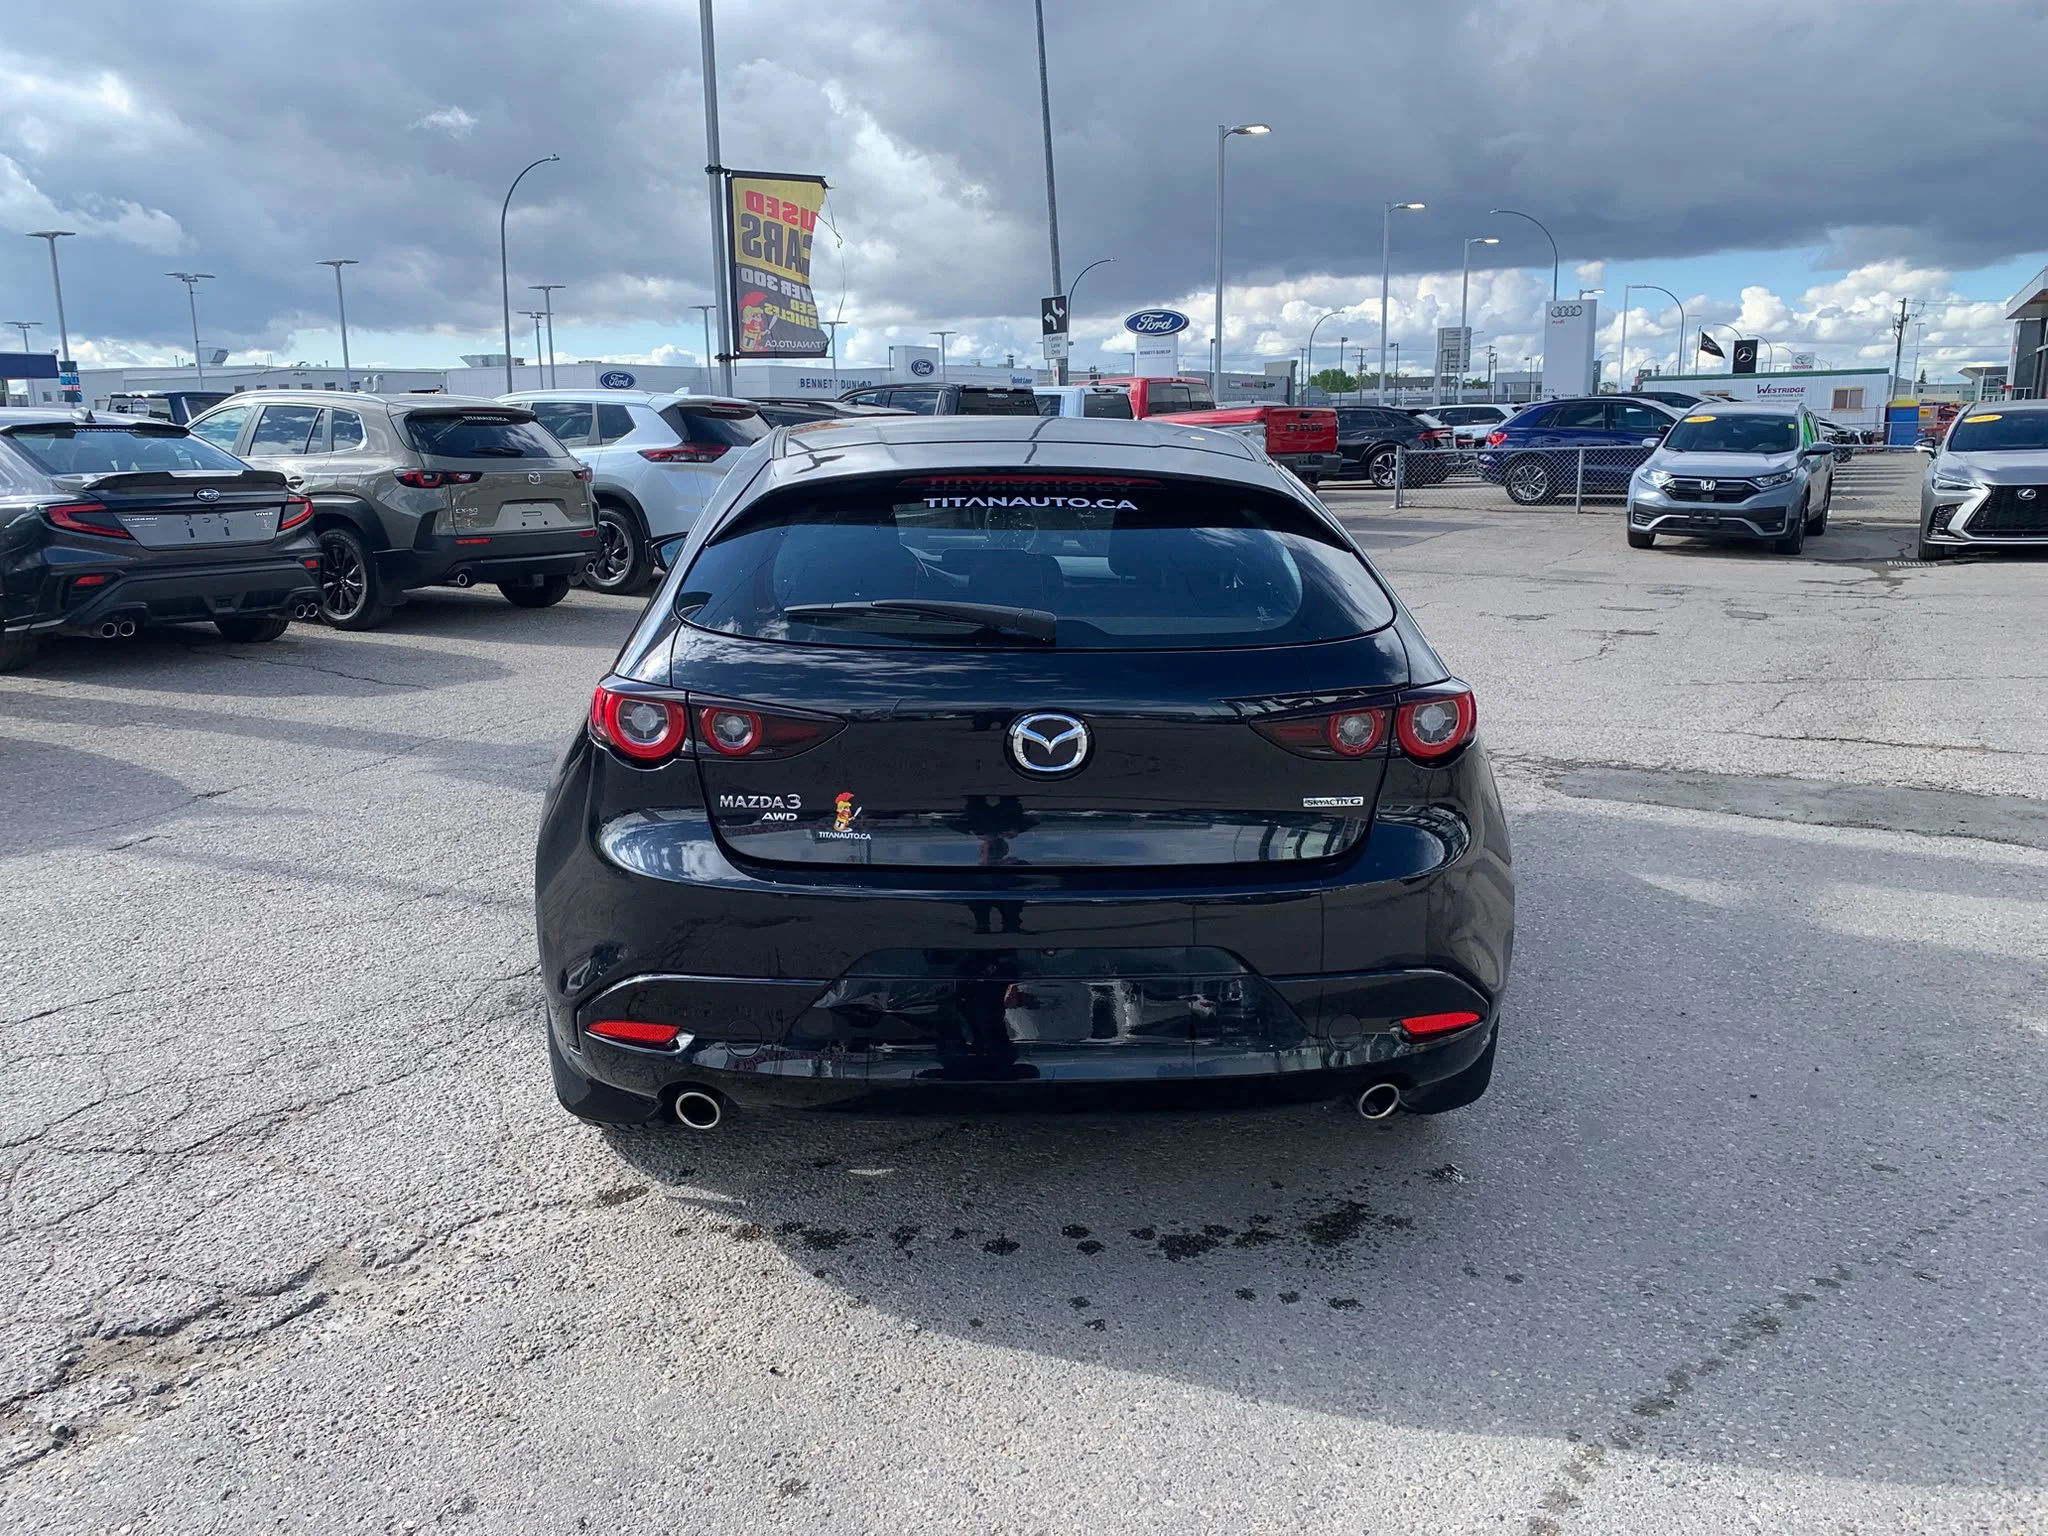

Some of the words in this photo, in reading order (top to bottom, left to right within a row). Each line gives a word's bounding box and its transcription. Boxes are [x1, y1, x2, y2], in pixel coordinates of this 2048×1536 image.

[1757, 383, 1806, 394] WESTRIDGE
[1285, 424, 1324, 433] RAM
[922, 496, 1139, 511] TITANAUTO.CA
[761, 812, 798, 822] AWD
[818, 830, 872, 840] TITANAUTO.CA
